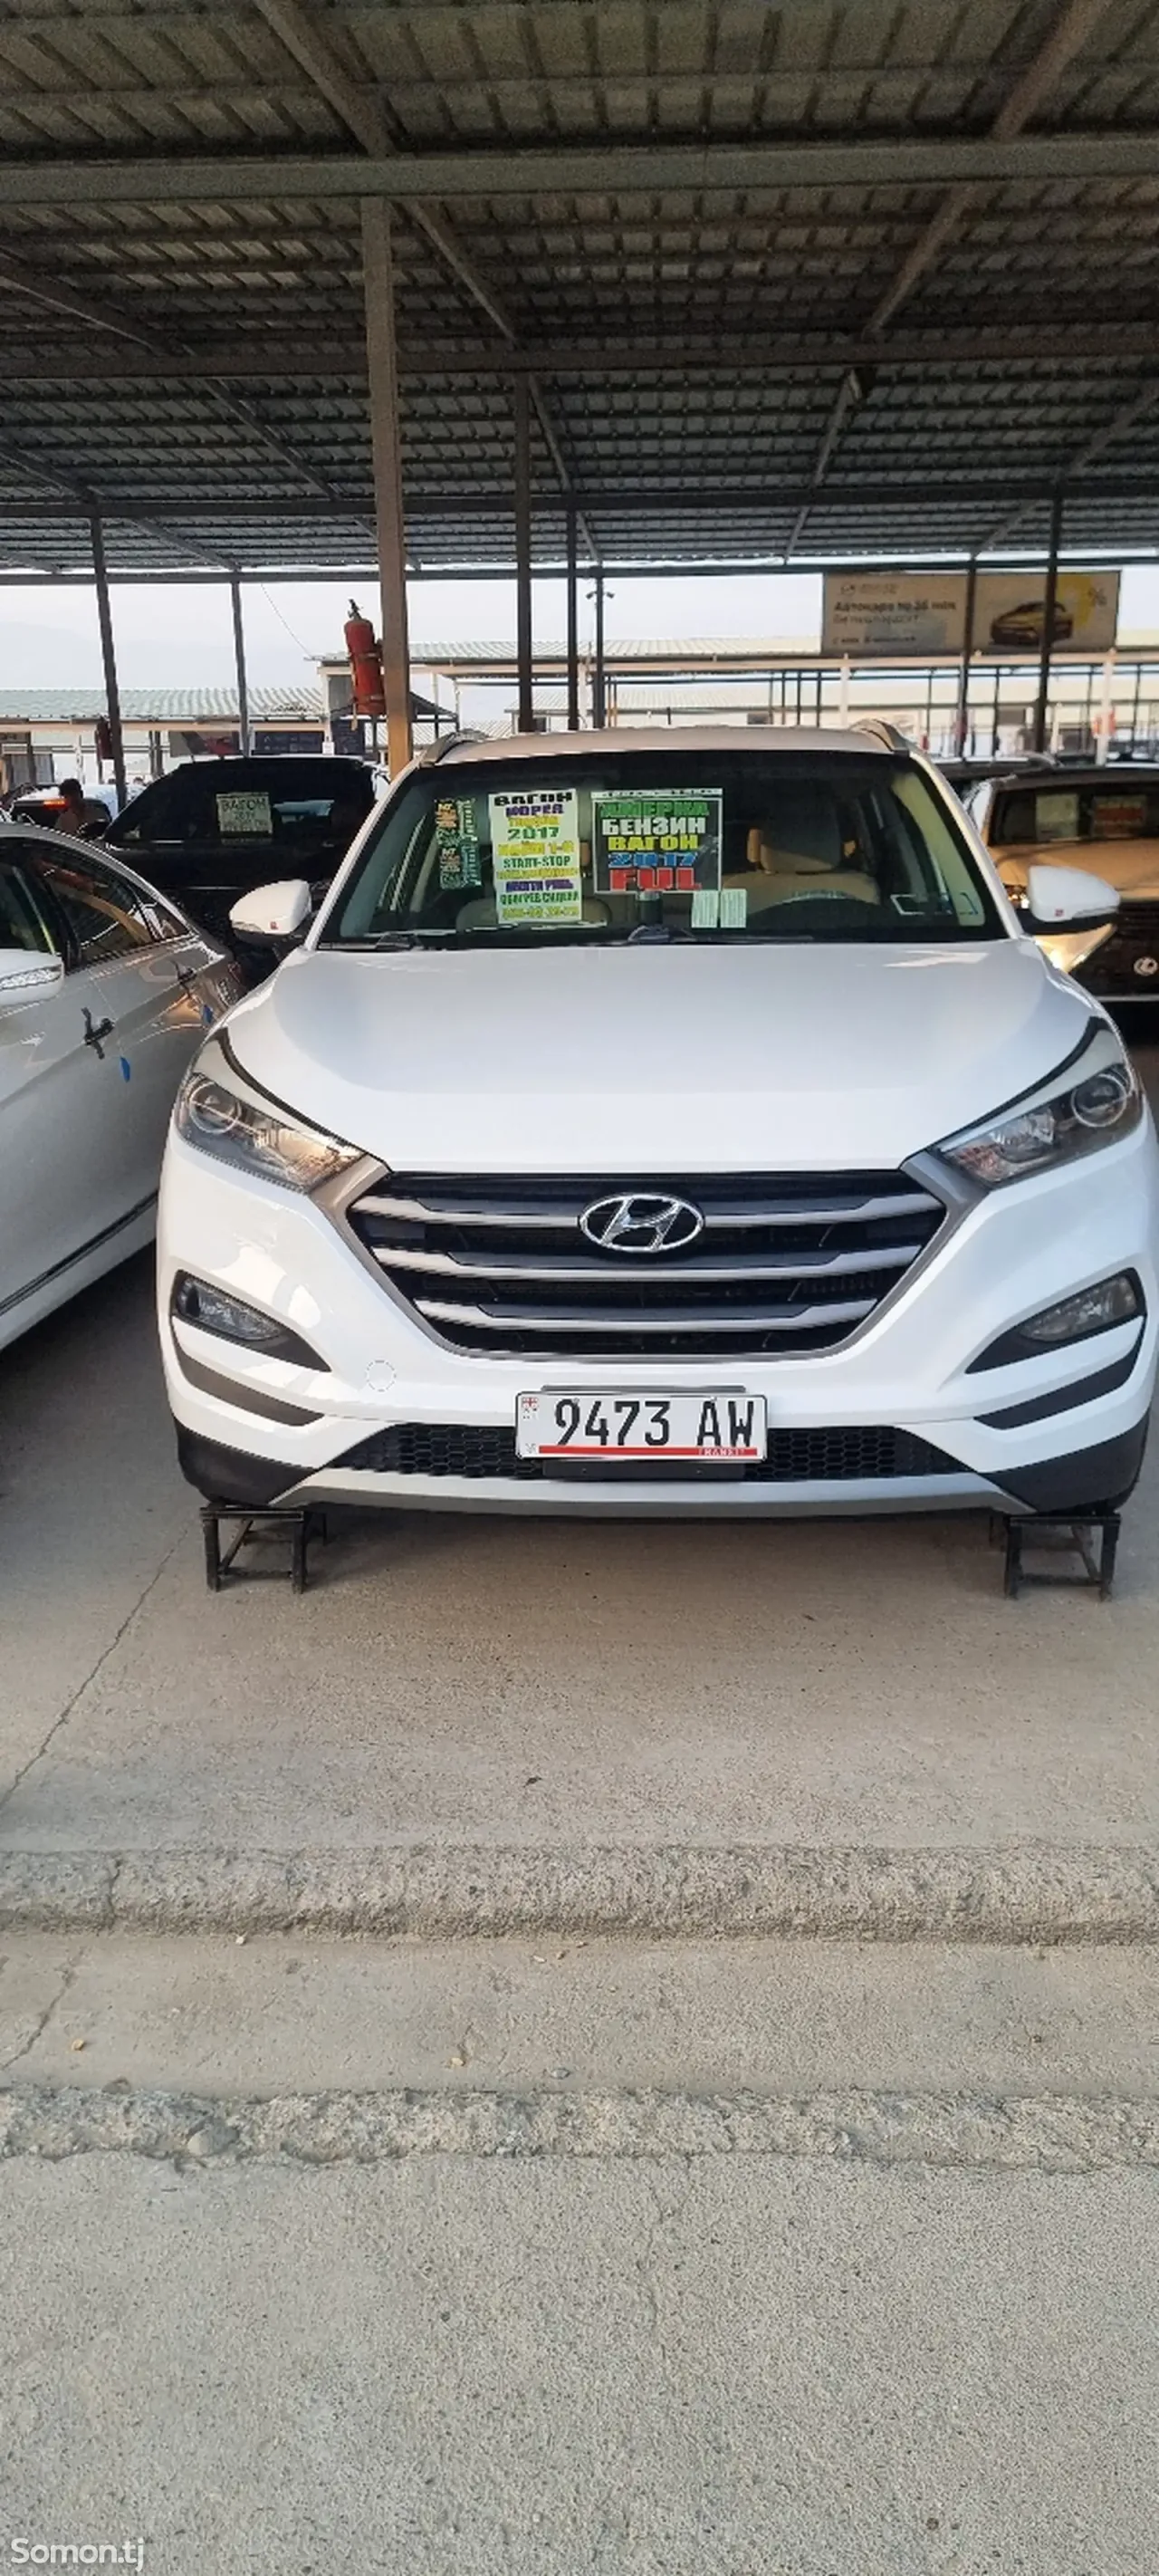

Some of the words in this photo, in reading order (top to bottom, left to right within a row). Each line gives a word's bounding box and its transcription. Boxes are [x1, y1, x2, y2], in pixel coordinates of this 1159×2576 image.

[493, 792, 572, 806] ВАГОН
[508, 826, 560, 841] 2017
[602, 816, 706, 836] БЕНЗИН
[608, 833, 699, 851] ВАГОН
[503, 855, 571, 869] START-STOP
[608, 851, 698, 869] 2017
[609, 867, 703, 892] FUL
[555, 1399, 671, 1447] 9473
[696, 1399, 754, 1448] AW
